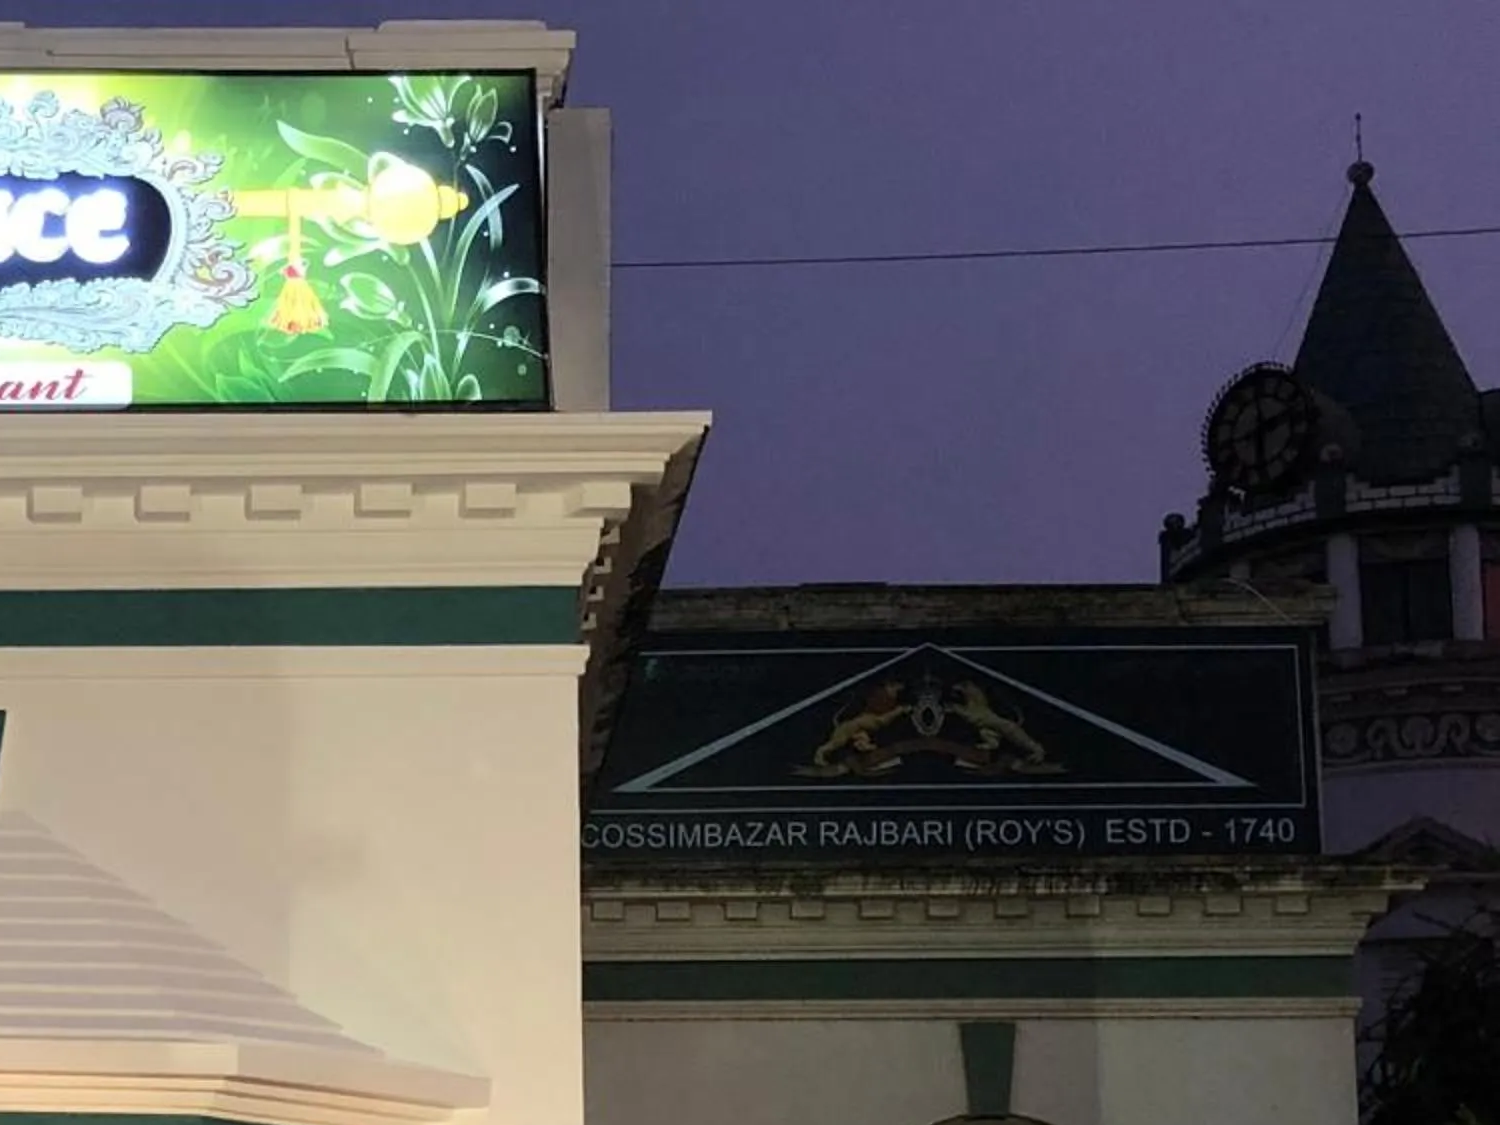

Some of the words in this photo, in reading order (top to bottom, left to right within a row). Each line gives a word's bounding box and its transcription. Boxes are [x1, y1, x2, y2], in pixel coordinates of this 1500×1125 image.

[581, 821, 809, 849] COSSIMBAZAR
[820, 820, 954, 846] RAJBARI
[965, 819, 1086, 850] (ROY'S)
[1105, 818, 1191, 844] ESTD
[1225, 817, 1296, 843] 1740
